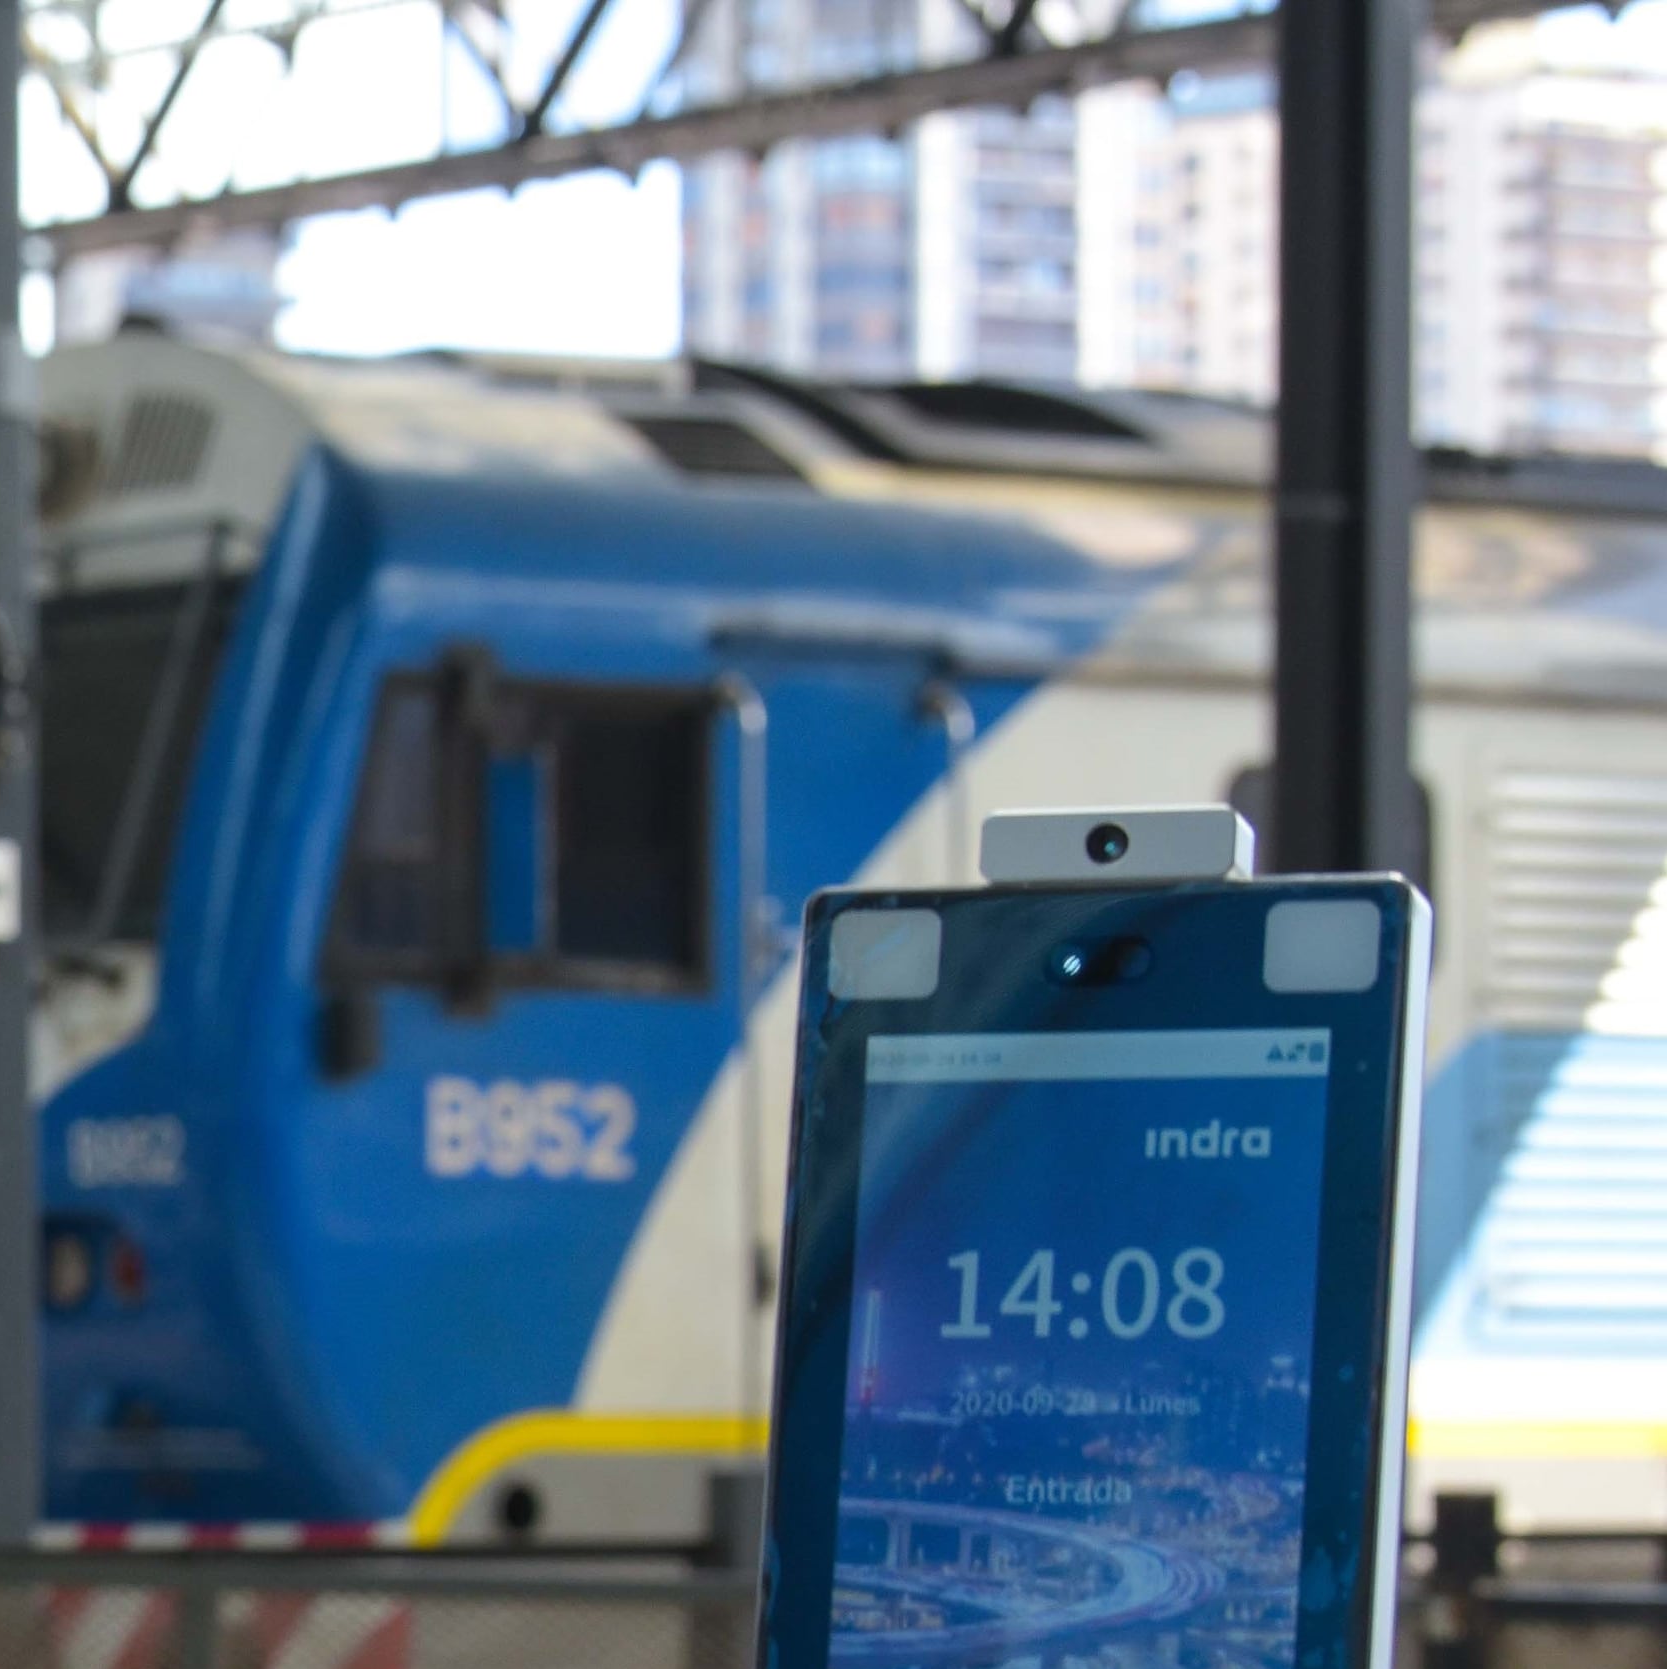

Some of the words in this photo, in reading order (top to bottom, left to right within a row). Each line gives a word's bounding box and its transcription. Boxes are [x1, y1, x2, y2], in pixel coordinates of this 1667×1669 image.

[425, 1075, 637, 1181] B952
[1145, 1119, 1271, 1159] indra
[940, 1246, 1225, 1340] 14:08
[1124, 1392, 1202, 1416] Lunes
[1005, 1474, 1133, 1504] Entrada
